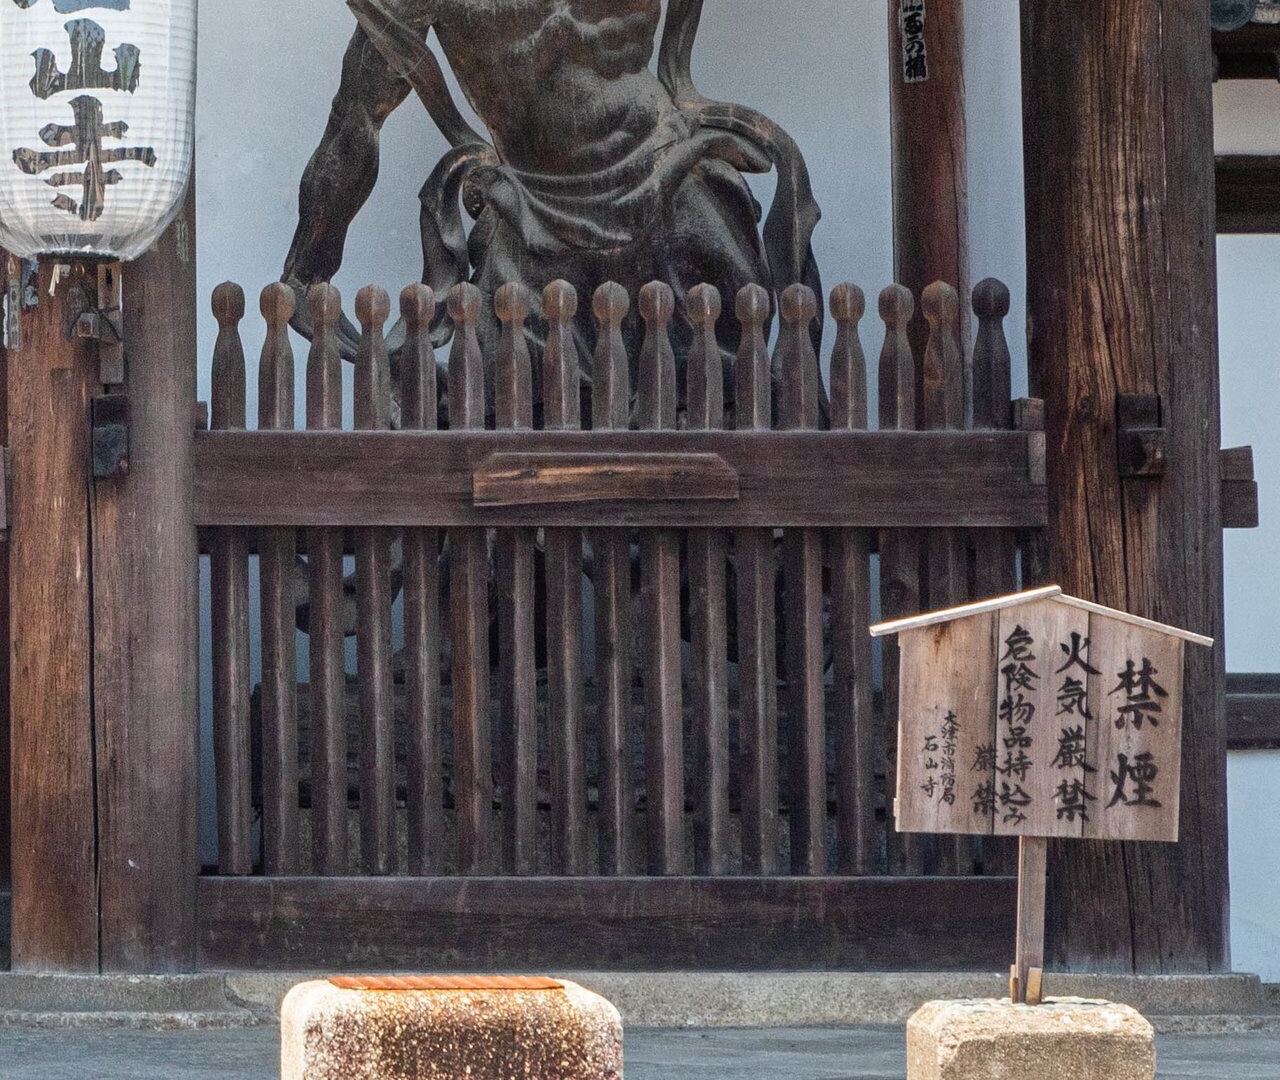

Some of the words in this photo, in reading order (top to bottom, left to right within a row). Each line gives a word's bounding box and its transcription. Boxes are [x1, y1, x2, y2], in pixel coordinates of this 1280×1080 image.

[921, 735, 939, 797] 石山寺
[970, 744, 1001, 817] 厳禁
[997, 625, 1040, 826] 危険物品持込み
[1052, 631, 1102, 823] 火気厳禁
[1106, 657, 1169, 810] 禁煙
